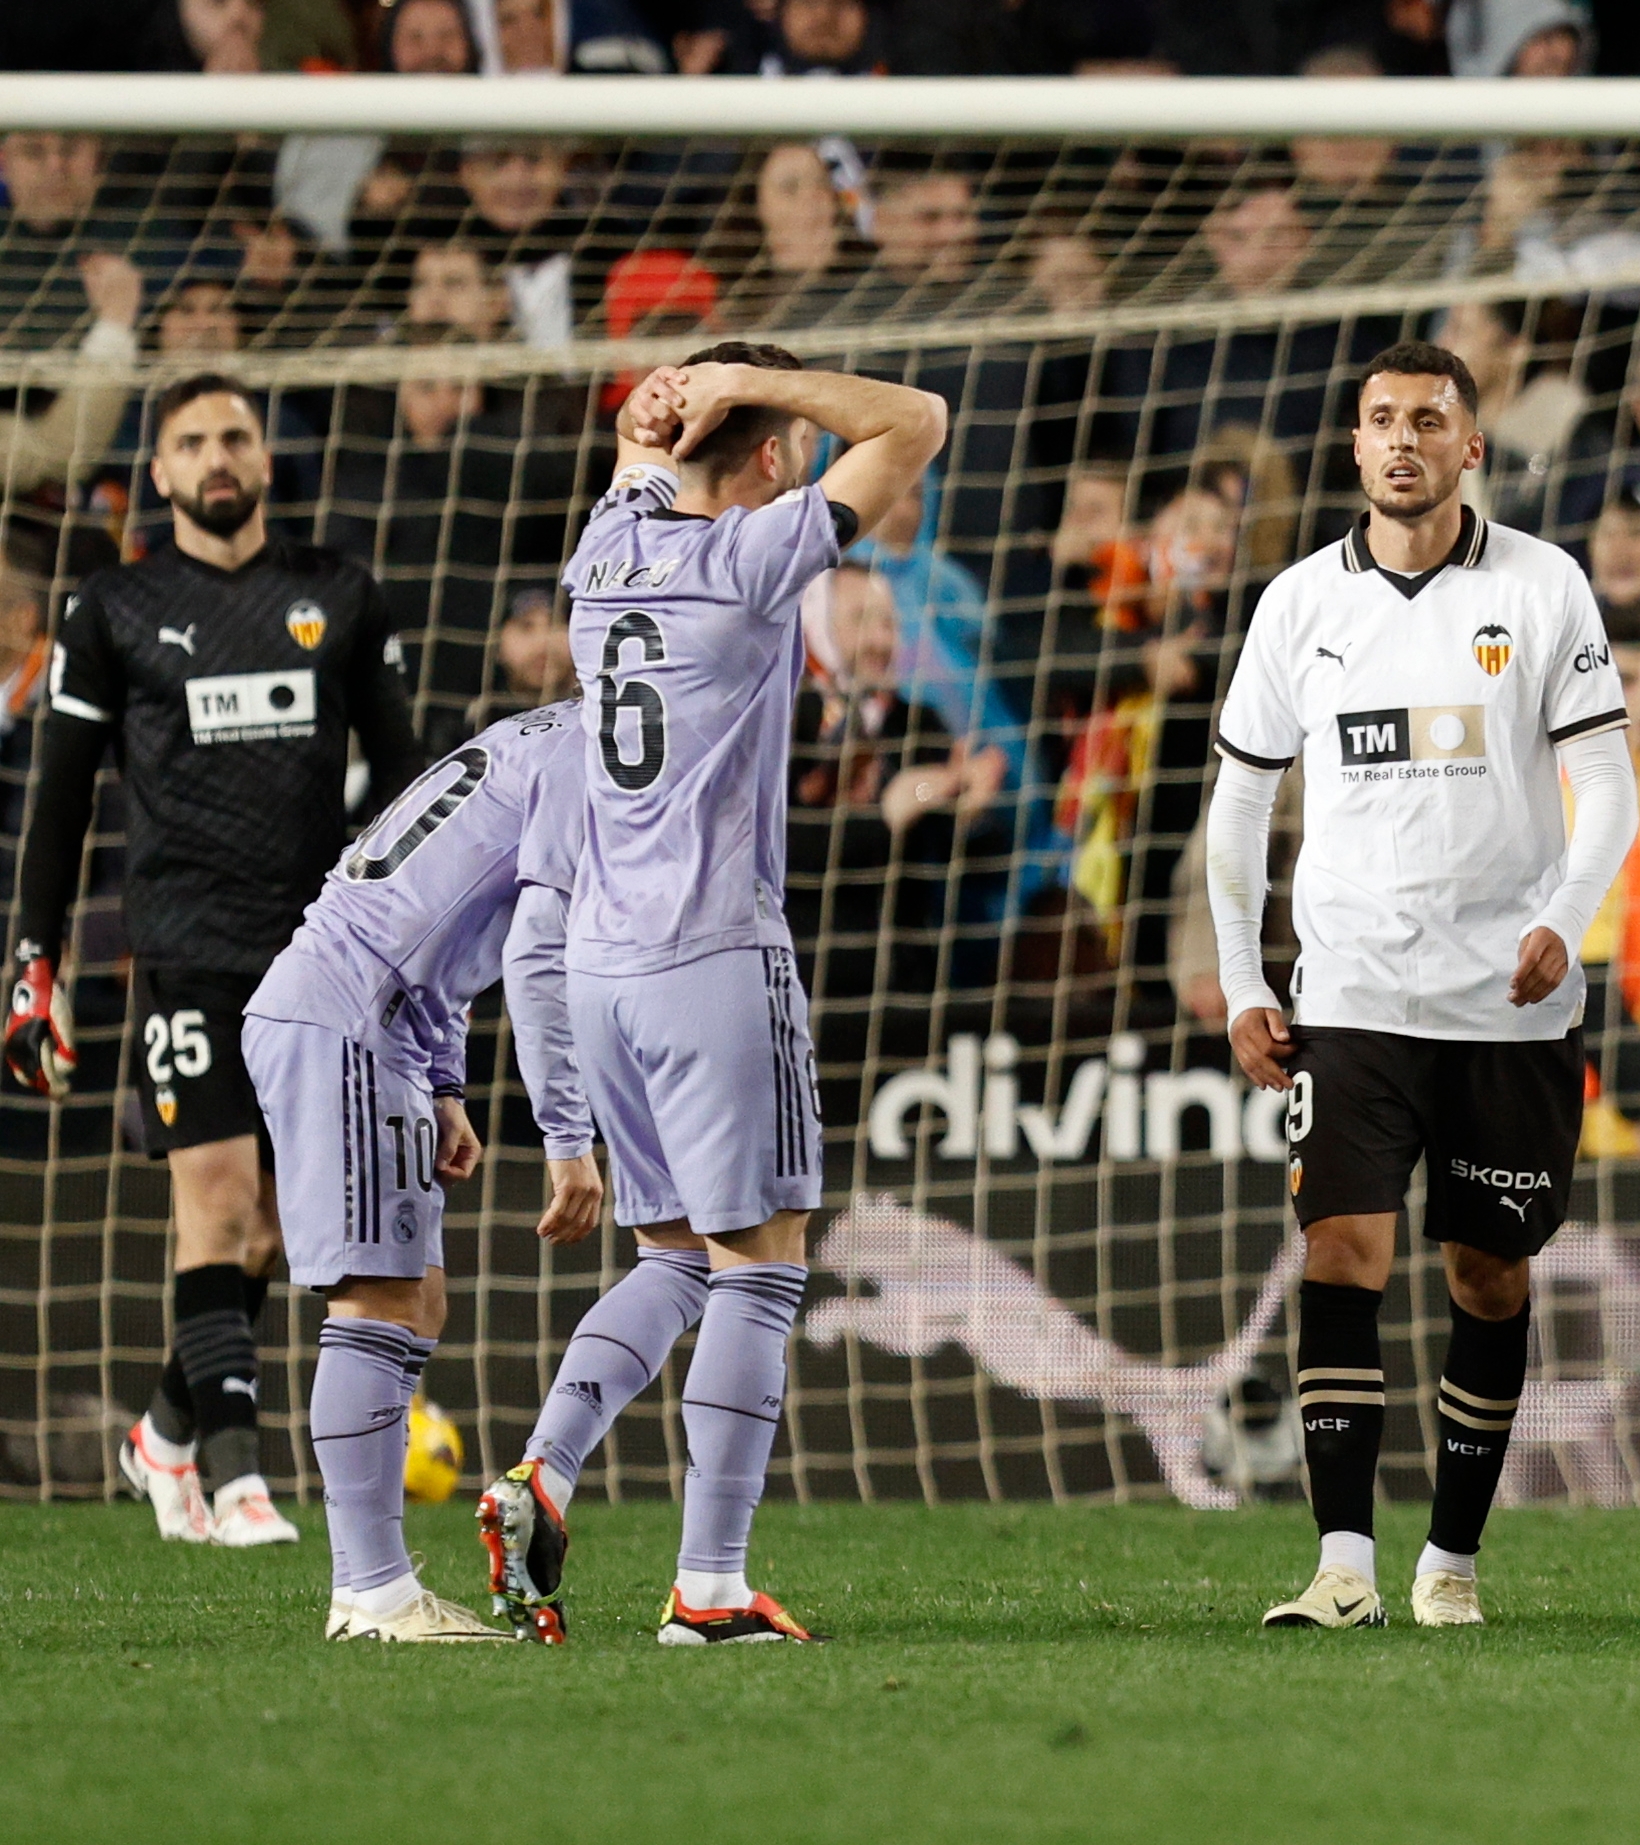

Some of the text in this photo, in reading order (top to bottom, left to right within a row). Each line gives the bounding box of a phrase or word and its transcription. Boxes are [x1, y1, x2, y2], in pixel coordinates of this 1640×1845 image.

[199, 692, 240, 716] TM
[599, 609, 669, 793] 6
[1347, 723, 1396, 755] TM
[1341, 762, 1487, 784] TM Real Estate Group
[144, 1008, 212, 1083] 25
[383, 1114, 436, 1194] 10
[556, 1386, 604, 1416] adidas
[1305, 1417, 1350, 1432] VCF
[1447, 1438, 1491, 1456] VCF
